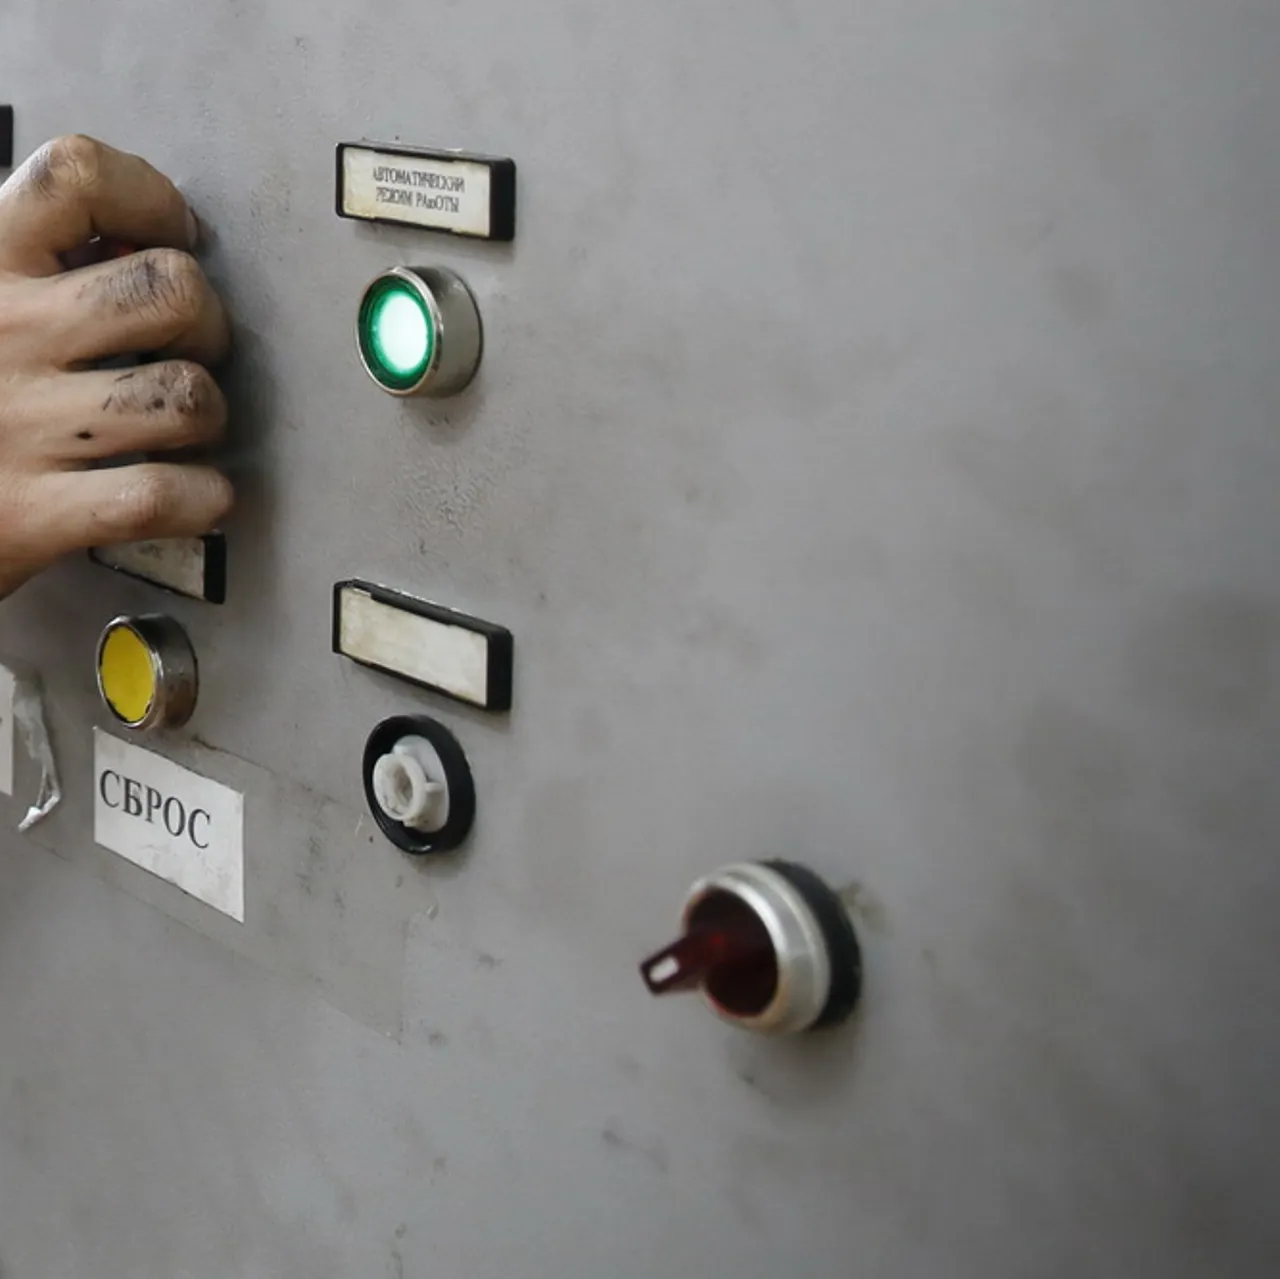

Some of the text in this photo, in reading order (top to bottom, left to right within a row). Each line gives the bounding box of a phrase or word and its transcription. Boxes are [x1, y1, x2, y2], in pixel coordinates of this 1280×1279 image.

[373, 166, 465, 194] АВТОМАТИЧЕСКИЙ
[376, 186, 414, 208] РЕЖИМ
[99, 769, 211, 850] СБРОС
